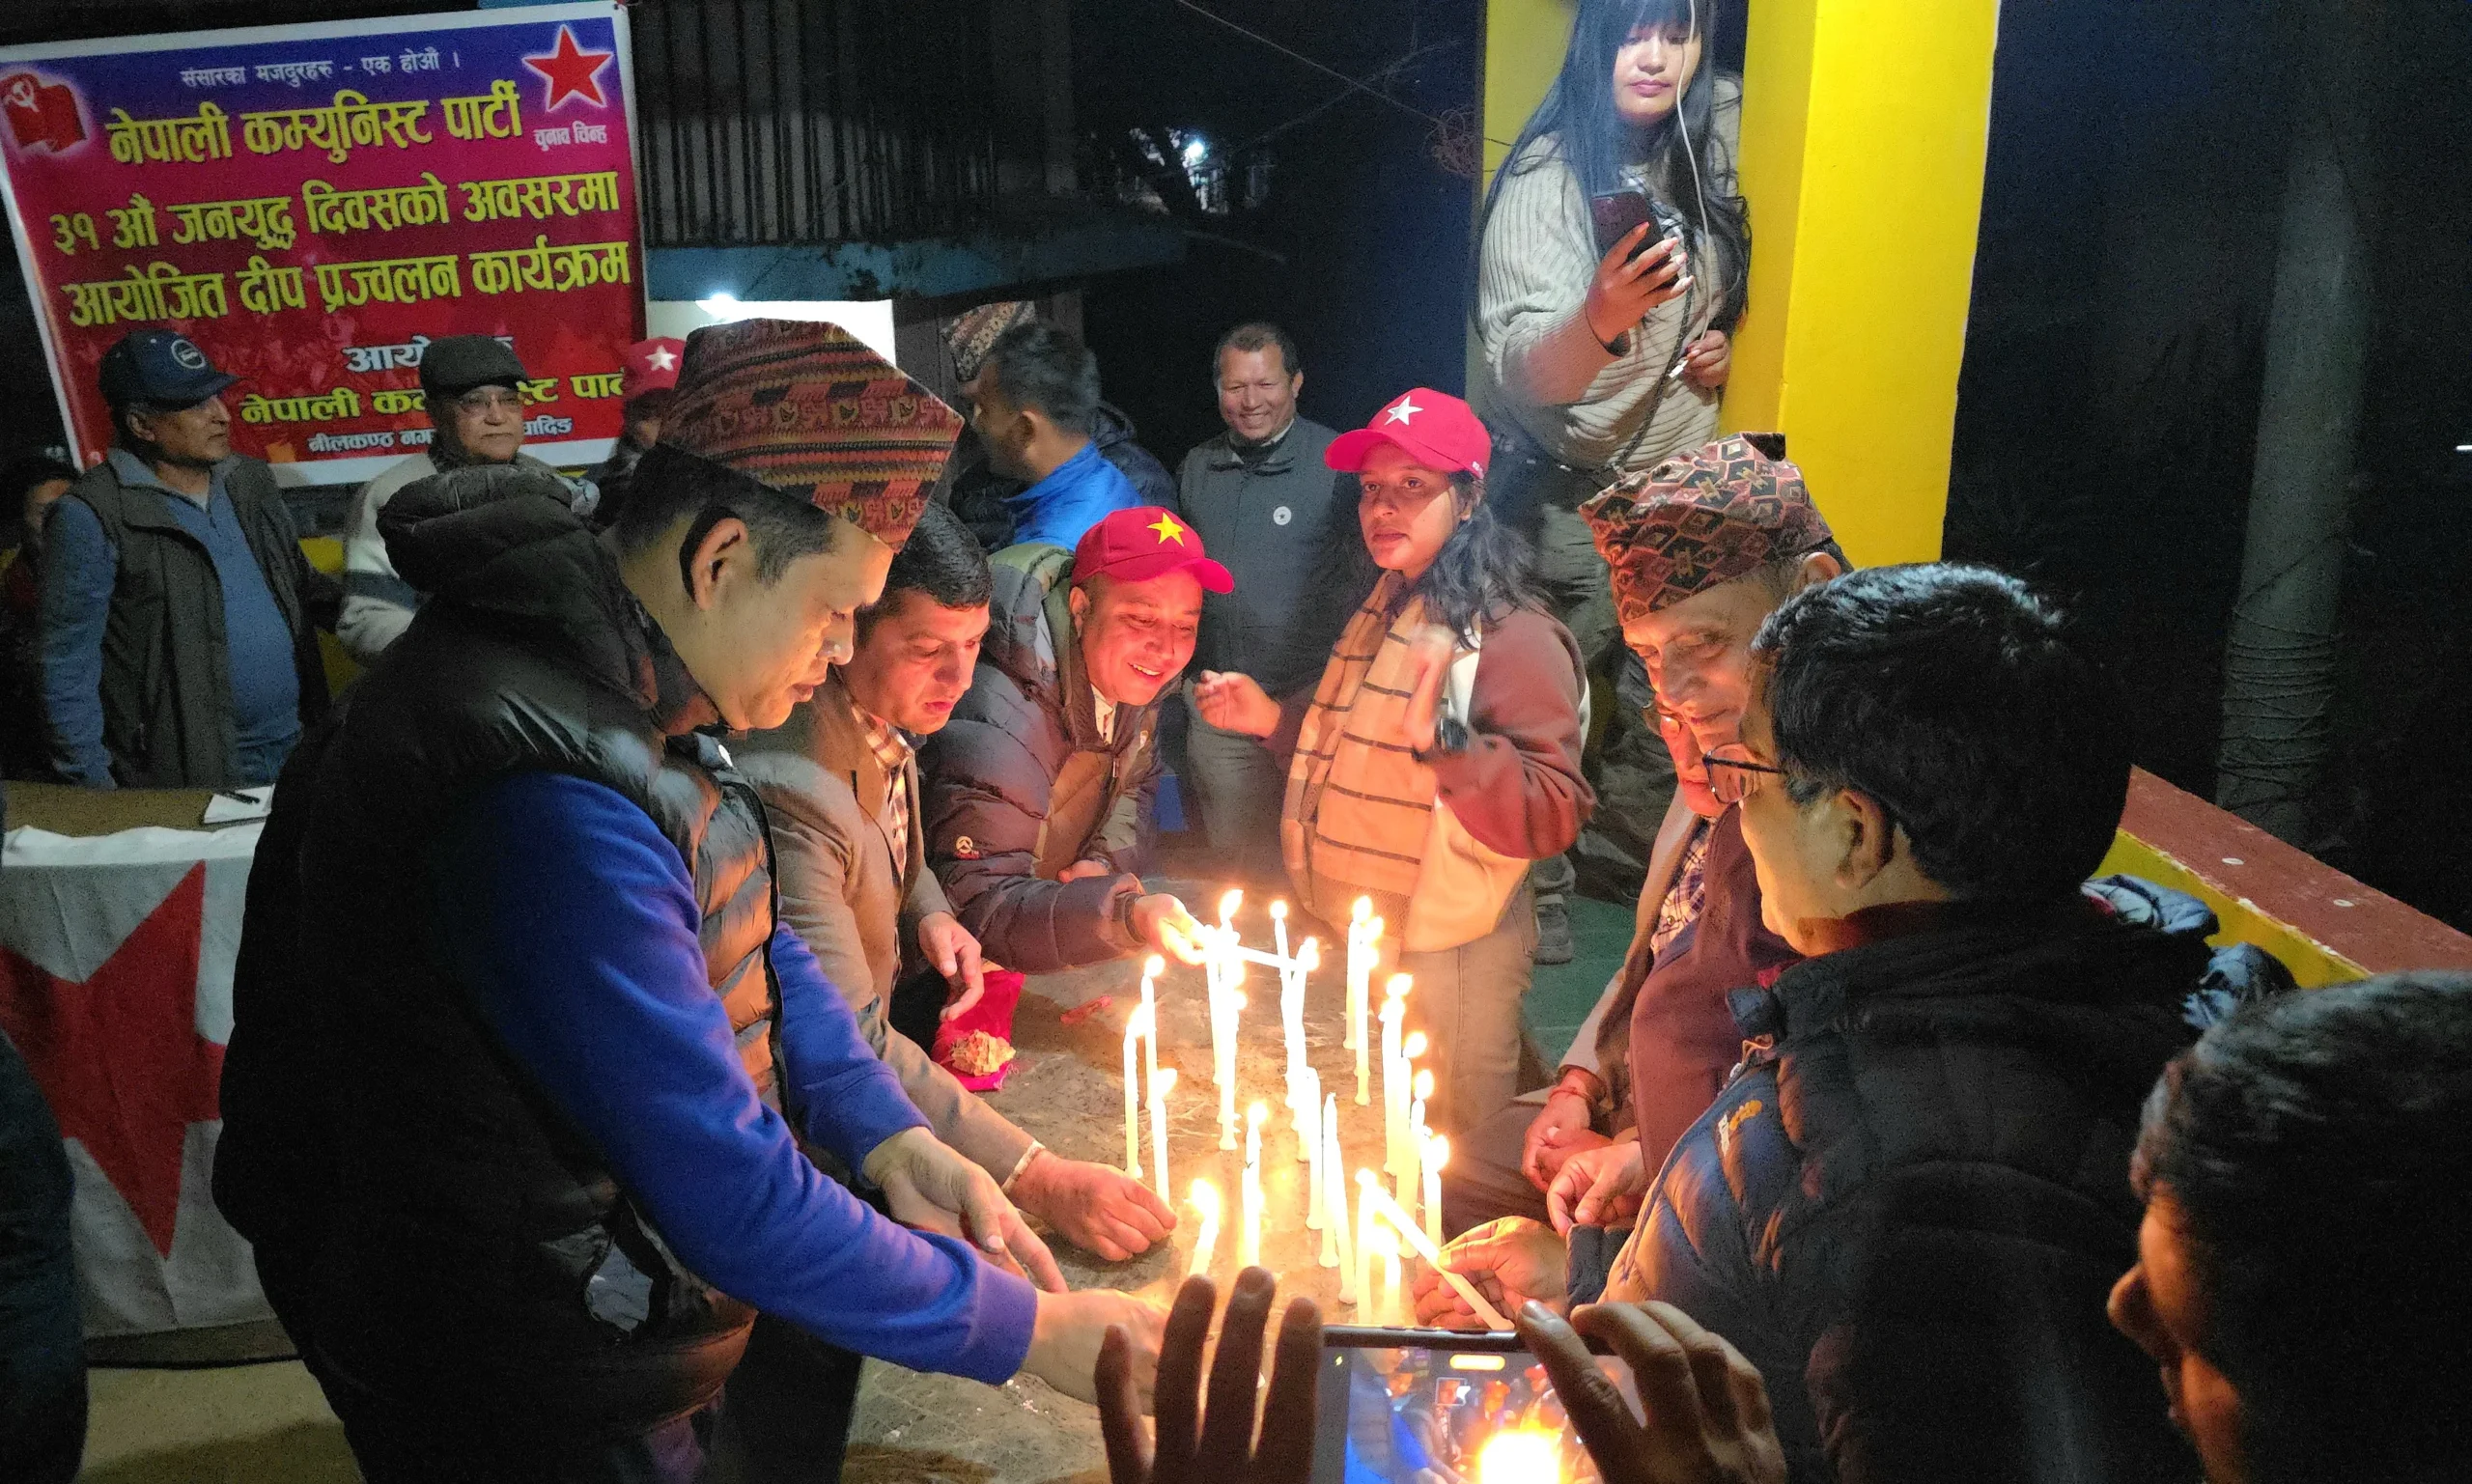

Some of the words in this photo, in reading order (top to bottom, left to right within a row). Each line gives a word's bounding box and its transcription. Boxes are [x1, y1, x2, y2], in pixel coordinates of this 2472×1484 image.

[360, 56, 392, 76] एक
[105, 100, 233, 164] नेपाली
[240, 88, 434, 164] कम्युनिस्ट
[440, 79, 522, 141] पार्टी
[533, 126, 572, 152] चुनाव
[572, 120, 608, 144] चिन्ह
[49, 211, 100, 256] ३१
[301, 172, 450, 235] दिवसको
[459, 170, 621, 223] अवसरमा
[61, 260, 229, 327] आयोजित
[236, 254, 307, 316] दीप
[313, 253, 462, 314] प्रज्वलन
[468, 234, 632, 294] कार्यक्रम
[239, 386, 361, 425] नेपाली
